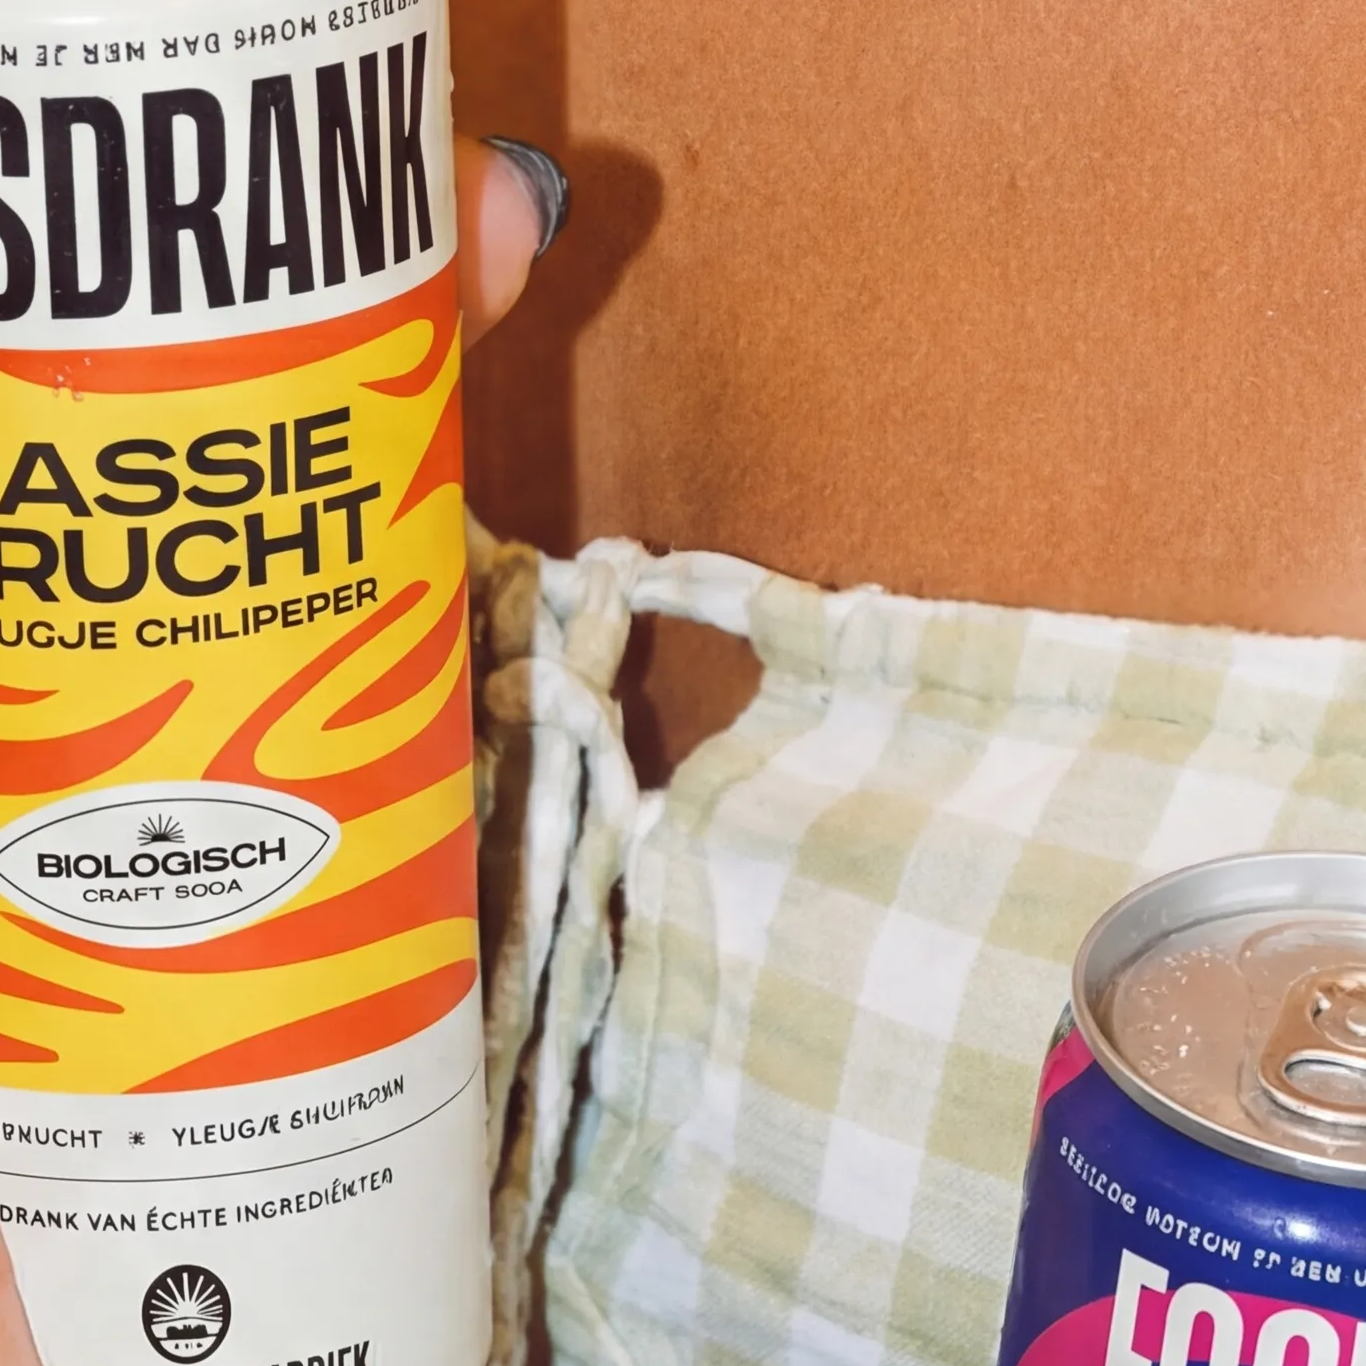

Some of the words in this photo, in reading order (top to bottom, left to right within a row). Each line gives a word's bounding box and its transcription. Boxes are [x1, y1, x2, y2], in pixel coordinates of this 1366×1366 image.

[134, 576, 379, 649] CHILIPEPER
[36, 837, 287, 880] BIOLOGISCH
[82, 885, 166, 904] CRAFT
[87, 1212, 137, 1233] VAN
[145, 1206, 229, 1234] ÉCHTE
